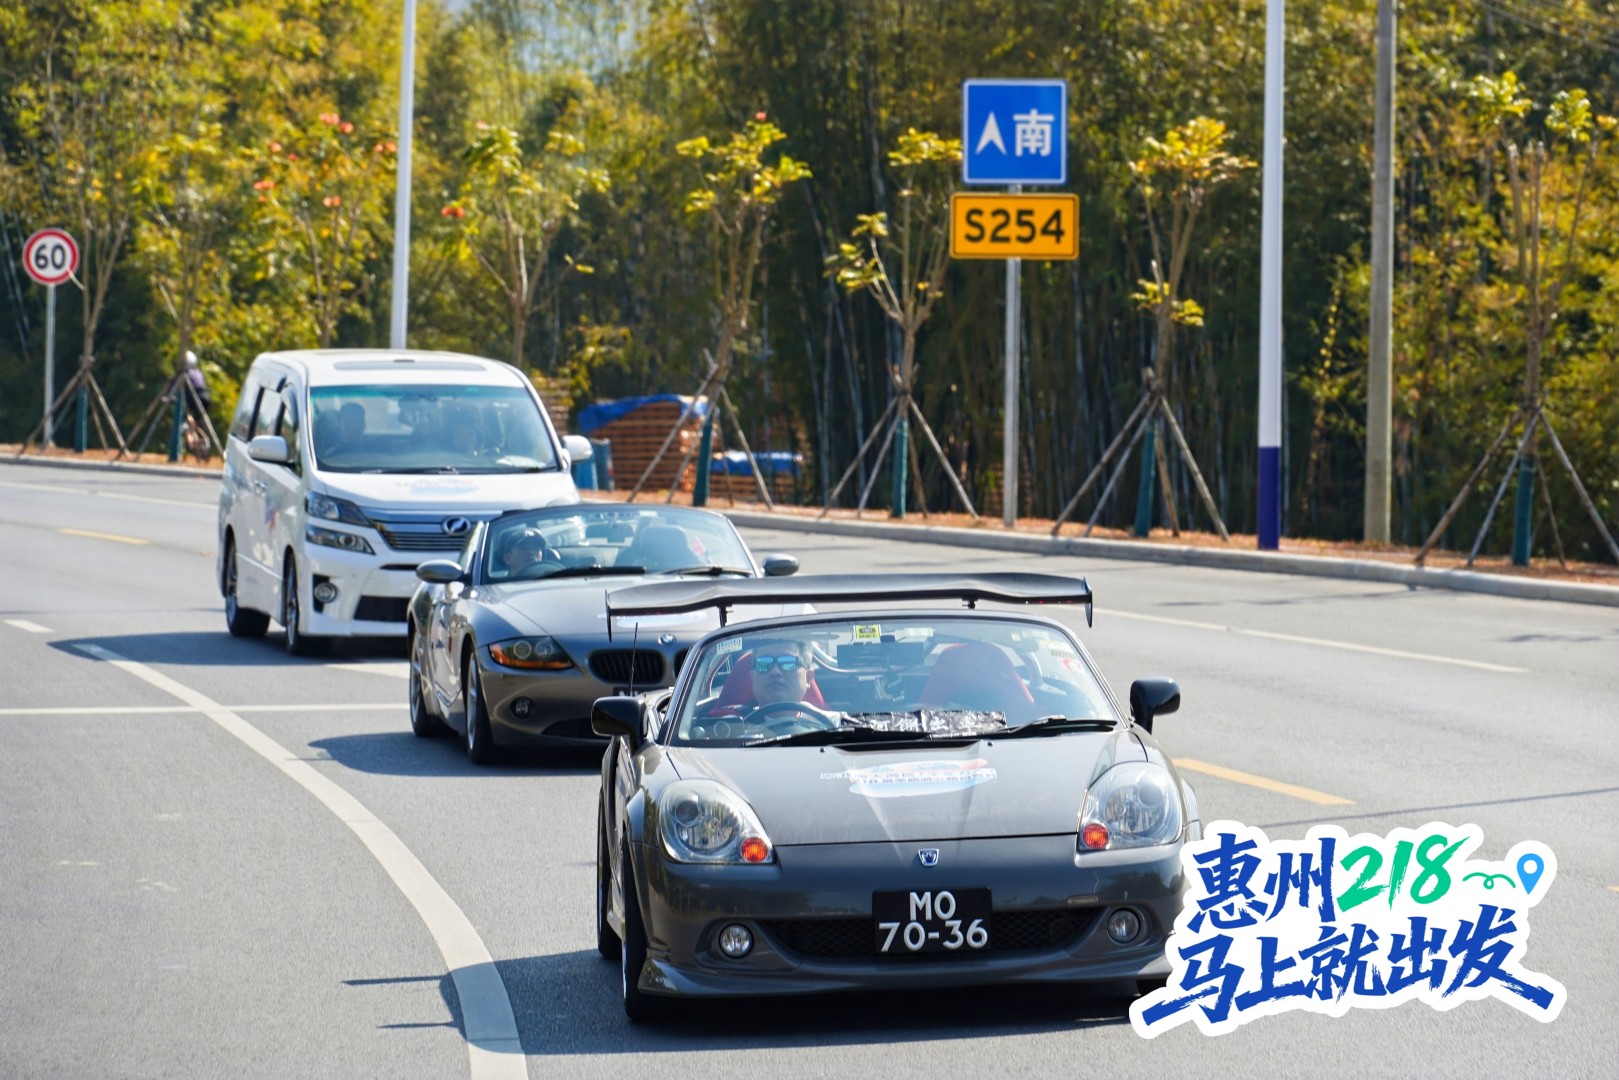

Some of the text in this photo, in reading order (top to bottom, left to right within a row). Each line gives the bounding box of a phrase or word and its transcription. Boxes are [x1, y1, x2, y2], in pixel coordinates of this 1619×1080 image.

[1013, 108, 1055, 158] 南
[964, 208, 1065, 244] S254
[34, 243, 66, 270] 60
[909, 890, 957, 921] MO
[878, 918, 989, 952] 70-36
